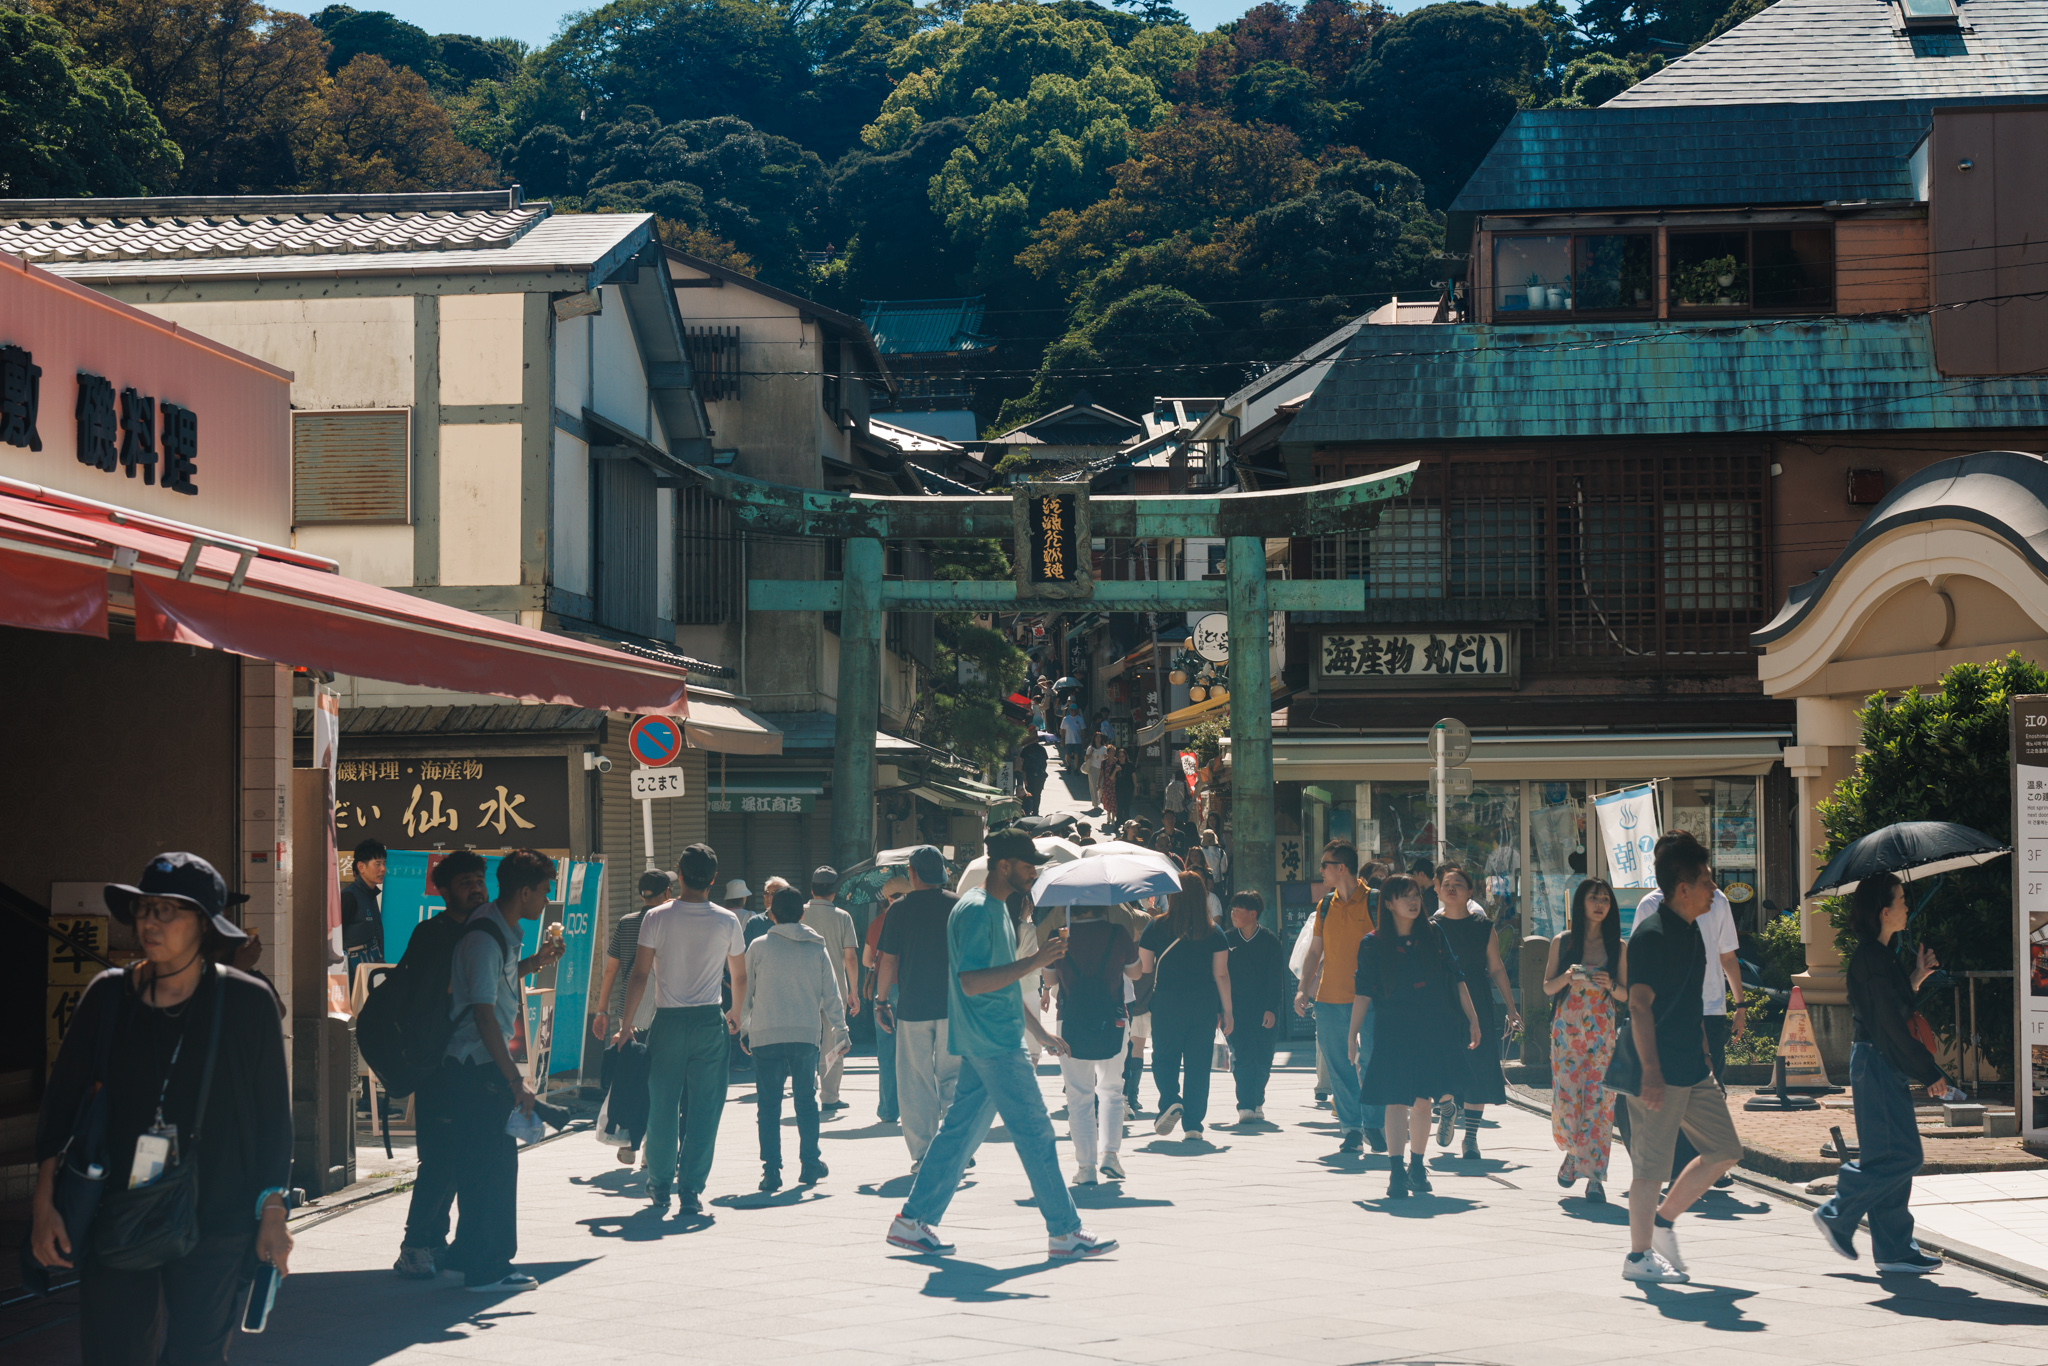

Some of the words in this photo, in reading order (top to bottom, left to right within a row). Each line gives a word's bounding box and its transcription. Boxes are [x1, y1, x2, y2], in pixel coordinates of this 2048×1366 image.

[75, 372, 198, 495] 磯料理
[1324, 635, 1415, 675] 海産物
[1421, 633, 1503, 674] 丸だい
[336, 759, 483, 782] 磯料理・海産物
[637, 775, 678, 792] ここまで
[402, 783, 536, 838] 仙水
[741, 796, 802, 813] 堀江商店
[2027, 850, 2041, 861] 3F
[2028, 883, 2042, 895] 2F
[566, 912, 588, 938] IQOS
[2031, 1022, 2044, 1033] 1F
